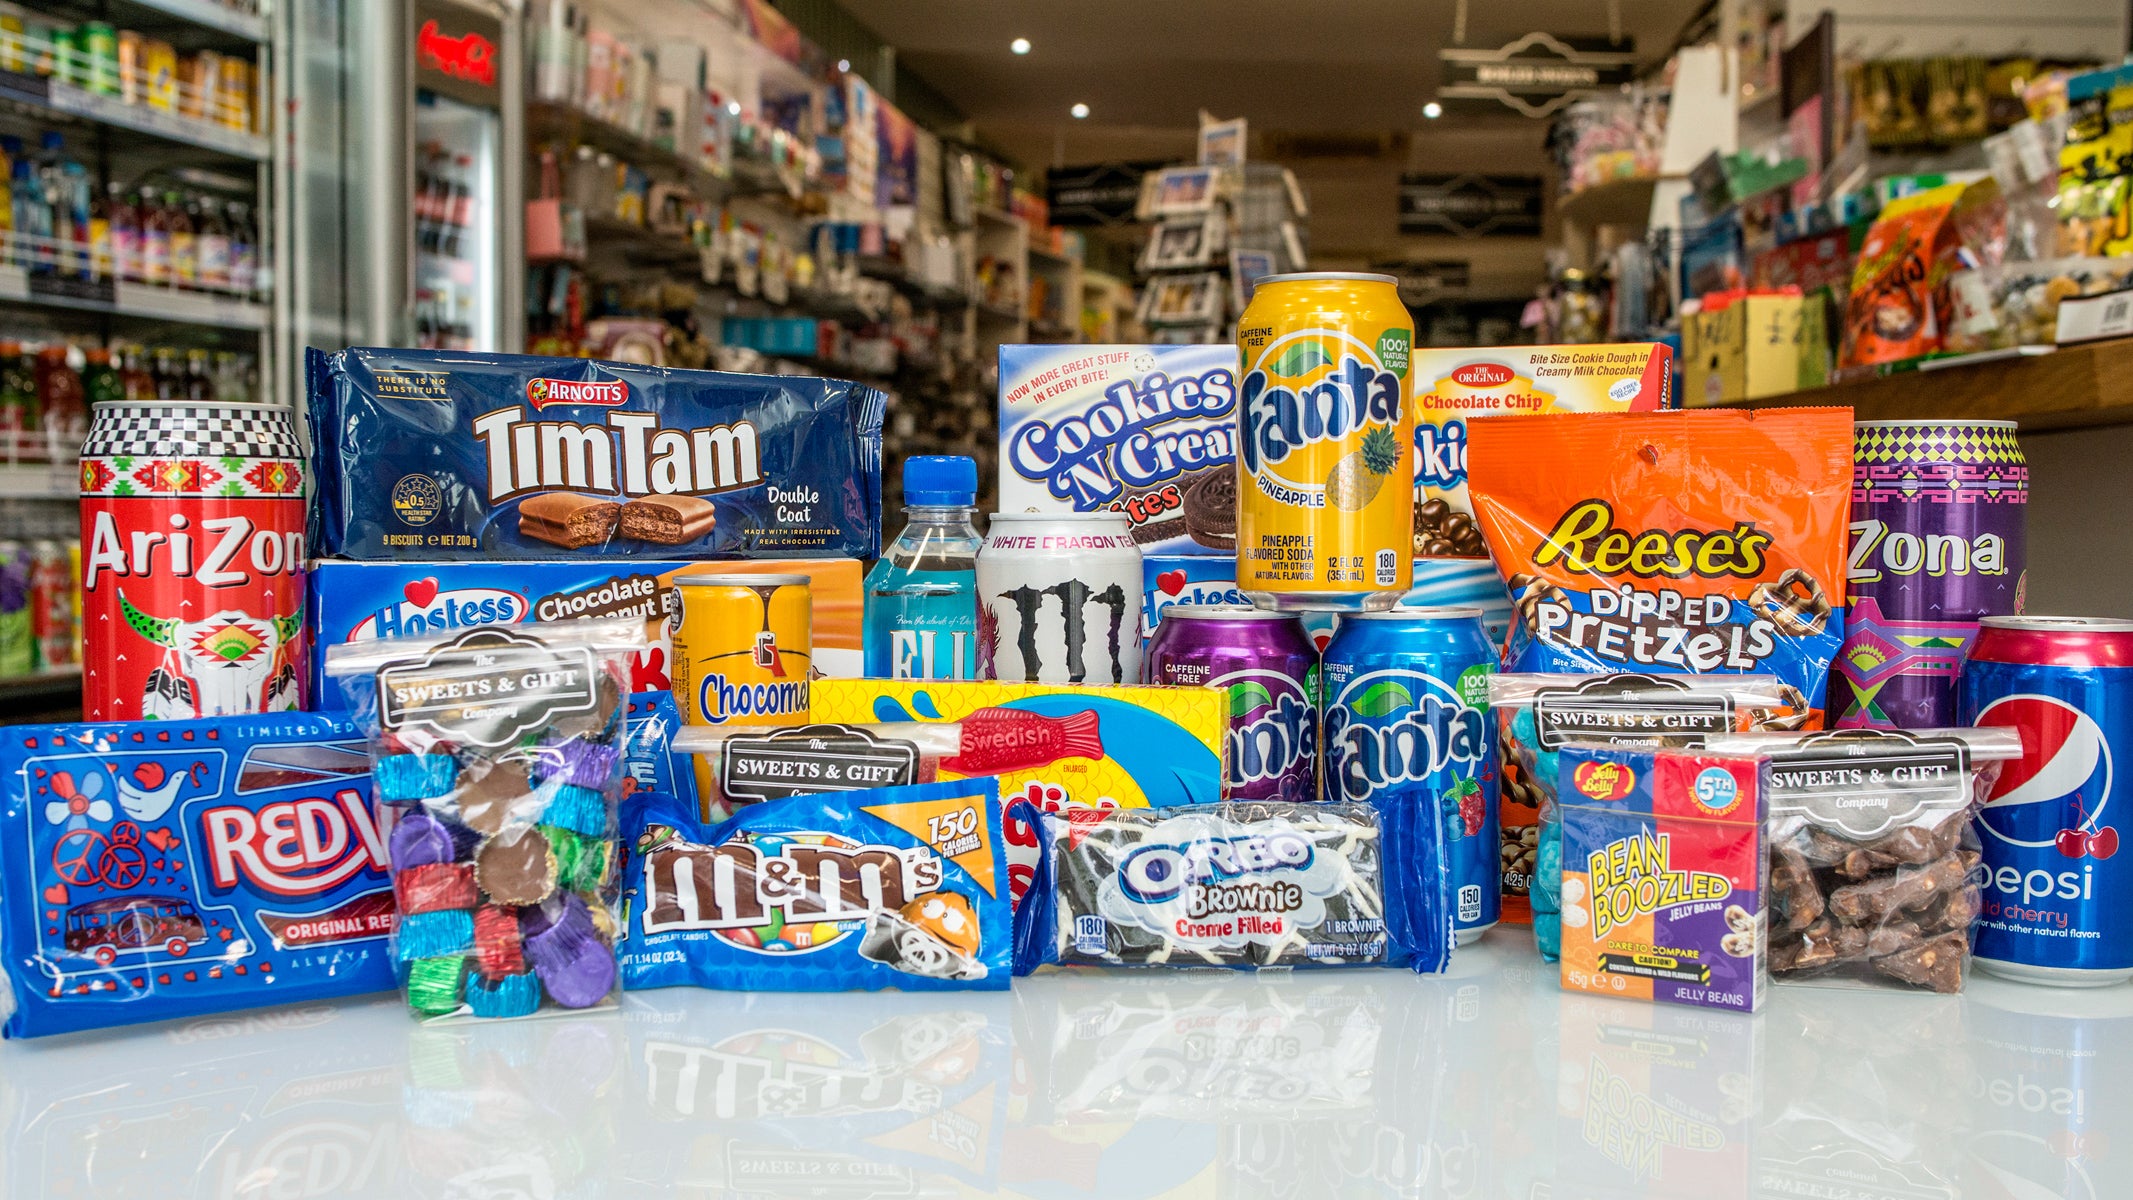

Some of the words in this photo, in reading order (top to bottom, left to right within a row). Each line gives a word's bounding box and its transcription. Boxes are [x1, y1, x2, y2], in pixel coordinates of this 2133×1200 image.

[1241, 327, 1273, 339] CAFFEINE
[1247, 337, 1264, 347] FREE
[1381, 338, 1408, 353] 100%
[1383, 352, 1408, 361] NATURAL
[1384, 360, 1408, 369] FLAVORS
[1529, 354, 1549, 365] Bite
[1550, 354, 1571, 364] Size
[1572, 353, 1605, 364] Cookie
[1606, 352, 1637, 365] Dough
[1639, 352, 1649, 362] in
[1006, 385, 1030, 404] NOW
[1031, 368, 1061, 389] MORE
[1061, 356, 1096, 376] GREAT
[1097, 351, 1131, 366] STUFF
[1458, 372, 1508, 383] ORIGINAL
[1475, 365, 1489, 374] THE
[1536, 366, 1572, 379] Creamy
[1574, 365, 1595, 376] Milk
[1597, 364, 1644, 376] Chocolate
[376, 375, 411, 385] THERE
[415, 377, 426, 386] IS
[431, 377, 446, 387] NO
[1033, 392, 1046, 405] IN
[1046, 375, 1081, 399] EVERY
[1082, 369, 1110, 385] BITE!
[378, 384, 447, 396] SUBSTITUTE
[548, 381, 622, 402] ARNOTT'S
[1423, 394, 1501, 410] Chocolate
[1504, 394, 1543, 412] Chip
[1017, 373, 1232, 473] Cookies
[767, 485, 819, 504] Double
[1257, 476, 1325, 508] PINEAPPLE
[777, 504, 811, 523] Coat
[383, 534, 389, 546] 9
[390, 534, 424, 546] BISCUITS
[441, 534, 455, 546] NET
[456, 535, 471, 546] 200
[992, 536, 1037, 550] WHITE
[1262, 535, 1314, 548] PINEAPPLE
[1536, 503, 1769, 575] Reese's
[86, 511, 305, 589] AriZon
[1246, 548, 1284, 561] FLAVORED
[1287, 548, 1314, 561] SODA
[1272, 561, 1289, 571] WITH
[1290, 561, 1314, 571] OTHER
[1327, 557, 1337, 568] 12
[1339, 557, 1350, 568] FL
[1352, 557, 1364, 568] OZ
[1378, 553, 1395, 568] 180
[1255, 571, 1281, 580] NATURAL
[1282, 571, 1314, 581] FLAVORS
[1326, 570, 1347, 583] (355
[539, 578, 655, 622] Chocolate
[375, 594, 515, 639] Hostess
[473, 654, 495, 668] The
[1165, 663, 1211, 675] CAFFEINE
[1324, 662, 1354, 675] CAFFEINE
[1553, 657, 1569, 668] Bite
[1177, 673, 1201, 684] FREE
[1330, 672, 1346, 683] FREE
[395, 679, 492, 704] SWEETS
[497, 677, 517, 693] &
[520, 670, 578, 691] GIFT
[701, 672, 810, 723] Chocomel
[1621, 690, 1641, 701] The
[462, 704, 519, 721] Company
[1550, 712, 1636, 727] SWEETS
[1641, 715, 1658, 728] &
[1662, 715, 1715, 728] GIFT
[237, 726, 320, 738] LIMITED
[961, 725, 1051, 753] Swedish
[808, 738, 829, 751] The
[1847, 744, 1867, 756] The
[737, 758, 820, 778] SWEETS
[825, 764, 841, 780] &
[847, 764, 899, 783] GIFT
[1063, 764, 1088, 774] ENLARGED
[1591, 761, 1621, 784] Jelly
[1771, 768, 1864, 788] SWEETS
[1868, 768, 1887, 784] &
[1891, 764, 1949, 783] GIFT
[1699, 776, 1733, 801] 5TH
[1835, 796, 1889, 811] Company
[928, 806, 979, 846] 150
[941, 832, 979, 851] CALORIES
[1120, 832, 1312, 897] OREO
[1590, 825, 1669, 898] BEAN
[648, 843, 941, 927] m&m's
[1461, 888, 1479, 904] 150
[1594, 871, 1731, 939] BOOZLED
[1668, 905, 1694, 922] JELLY
[1693, 901, 1723, 914] BEANS
[2004, 904, 2068, 929] cherry
[286, 918, 365, 939] ORIGINAL
[1079, 917, 1103, 936] 180
[1175, 918, 1233, 938] Creme
[1238, 916, 1283, 934] Filled
[1334, 919, 1382, 933] BROWNIE
[1990, 920, 2007, 931] with
[2008, 924, 2032, 935] other
[2033, 928, 2068, 938] natural
[2069, 928, 2101, 939] flavors
[644, 934, 681, 947] CHOCOLATE
[681, 931, 709, 941] CANDIES
[1345, 943, 1358, 956] OZ
[1359, 941, 1382, 957] (85g)
[1607, 940, 1633, 952] DARE
[1635, 943, 1648, 953] TO
[1650, 944, 1700, 960] COMPARE
[1638, 955, 1673, 967] CAUTION!
[1567, 970, 1588, 989] 45g
[1674, 987, 1704, 1002] JELLY
[1707, 991, 1745, 1007] BEANS
